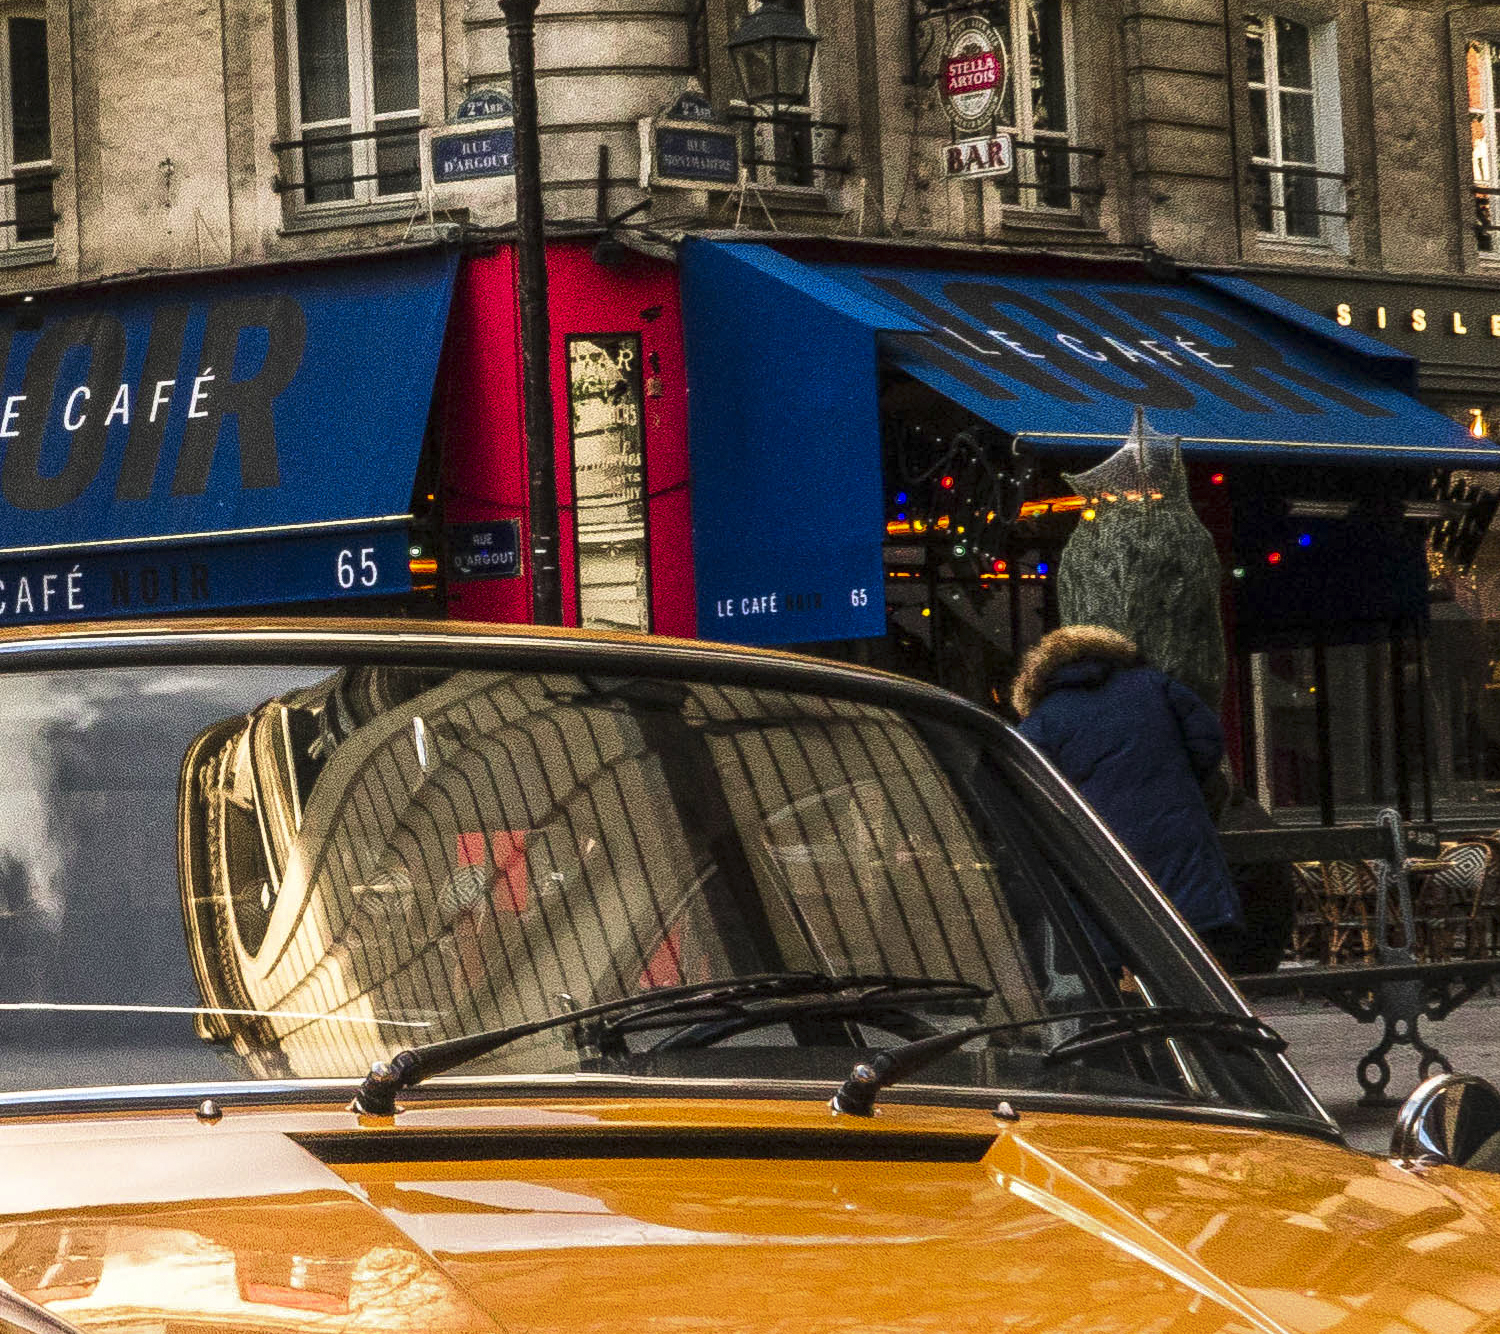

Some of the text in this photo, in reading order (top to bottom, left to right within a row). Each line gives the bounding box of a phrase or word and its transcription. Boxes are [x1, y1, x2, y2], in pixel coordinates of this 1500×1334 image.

[948, 57, 995, 77] STELLA
[948, 69, 996, 90] ARTOIS
[461, 141, 493, 156] RUE
[947, 141, 1005, 174] BAR
[443, 153, 510, 173] D'ARGOUT
[942, 327, 1235, 370] LE CAFÉ
[63, 367, 216, 432] CAFÉ
[473, 532, 493, 546] RUE
[336, 547, 378, 589] 65
[108, 561, 212, 609] NOIR
[716, 598, 735, 618] LE
[741, 590, 778, 616] CAFÉ
[849, 587, 868, 608] 65
